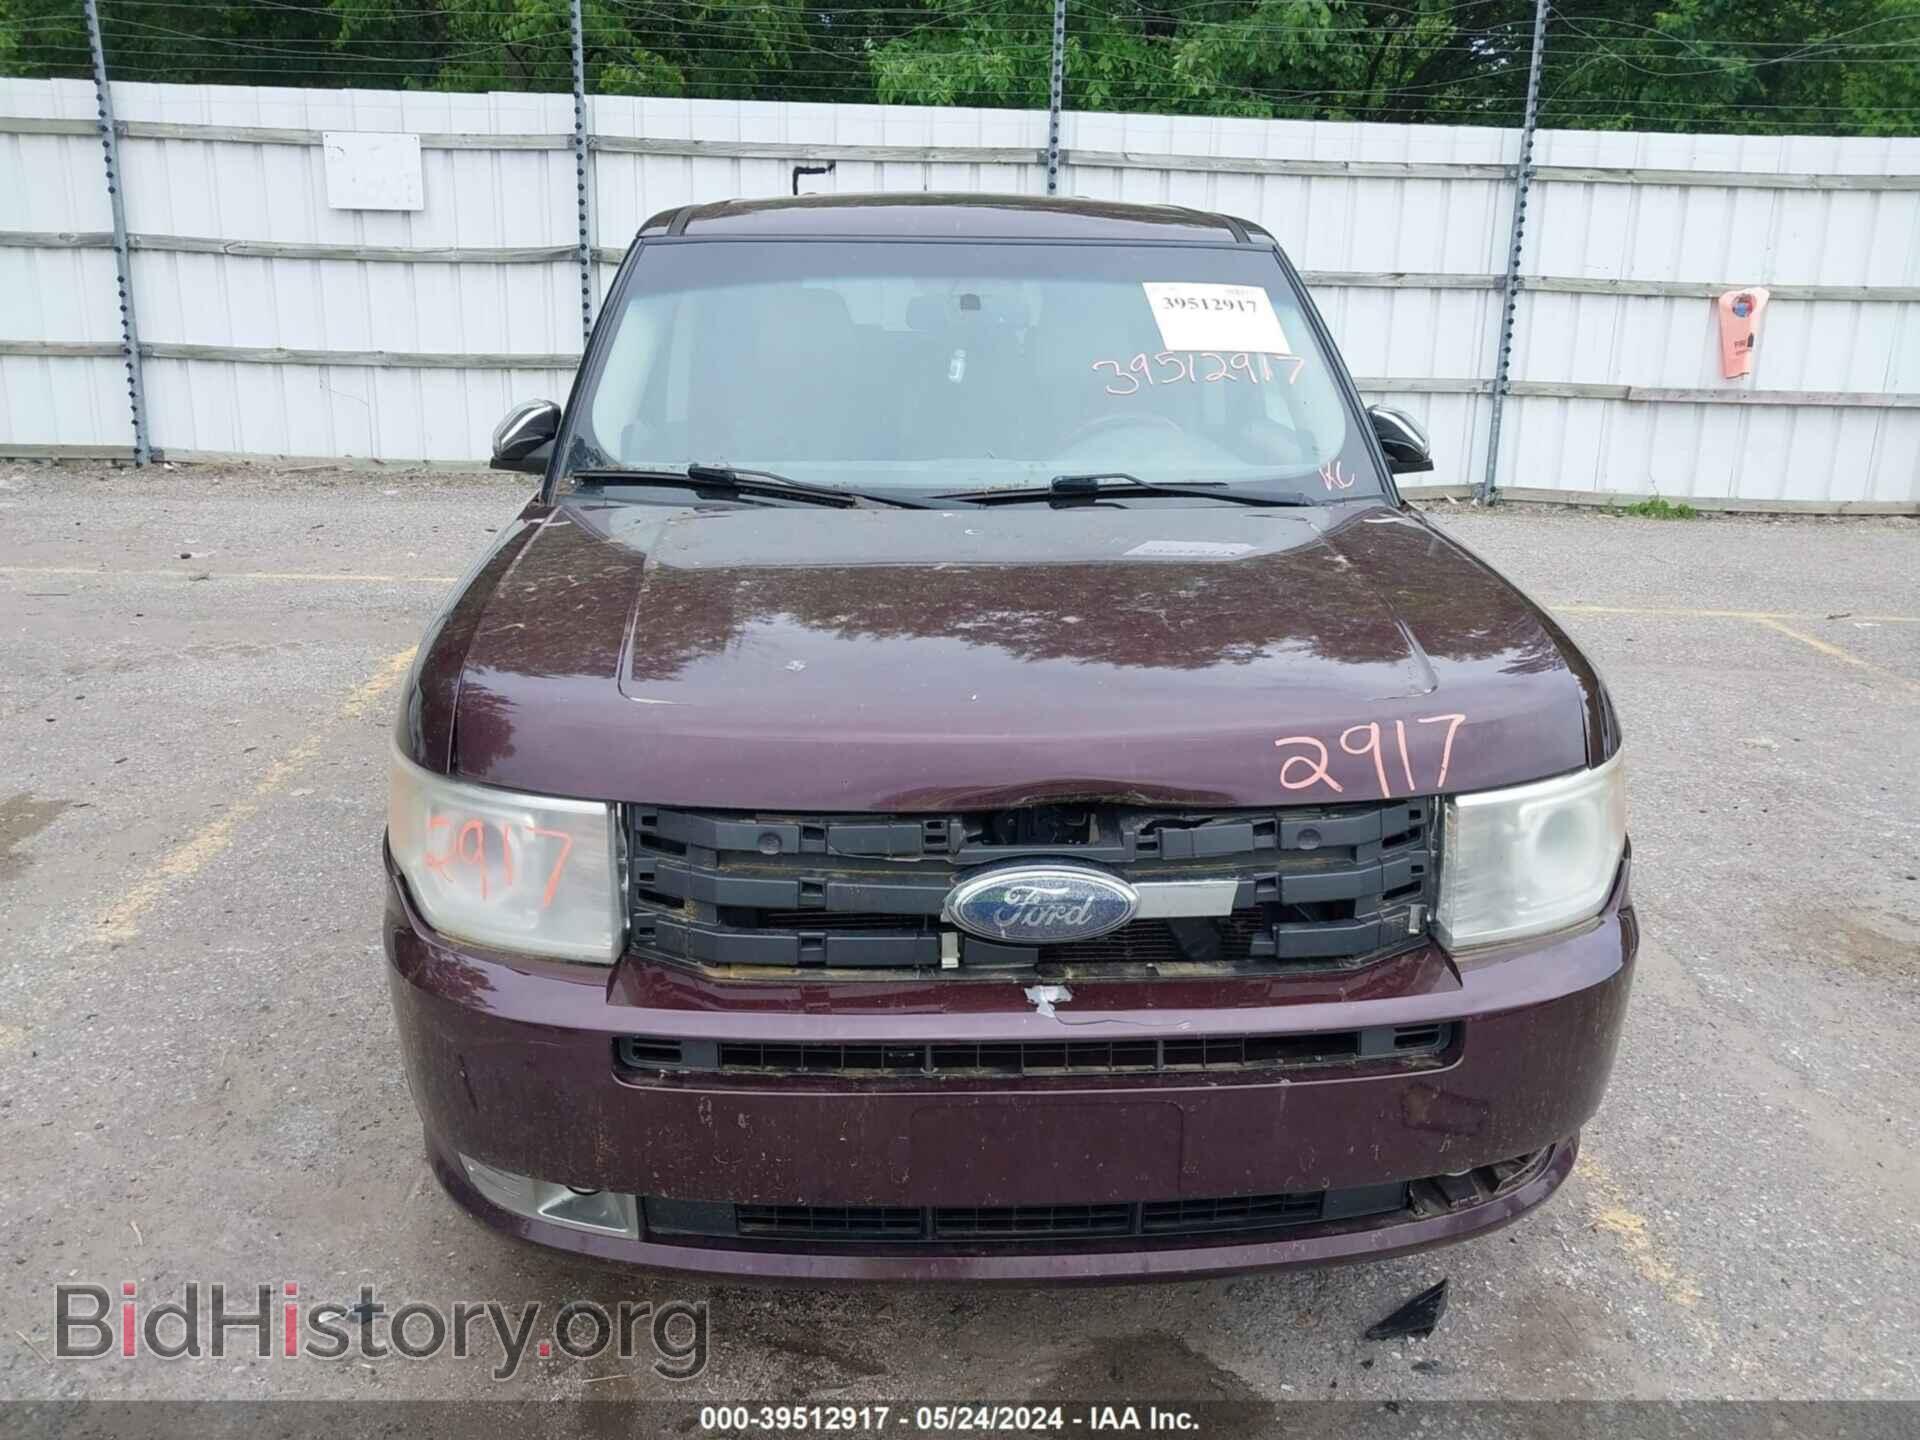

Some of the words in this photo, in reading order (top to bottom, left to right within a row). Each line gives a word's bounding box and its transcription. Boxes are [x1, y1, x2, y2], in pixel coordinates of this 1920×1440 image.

[1163, 296, 1257, 313] 39512917
[1091, 352, 1304, 394] 39512917
[1274, 713, 1467, 799] 2917
[423, 815, 574, 911] 2917
[992, 885, 1093, 928] Ford
